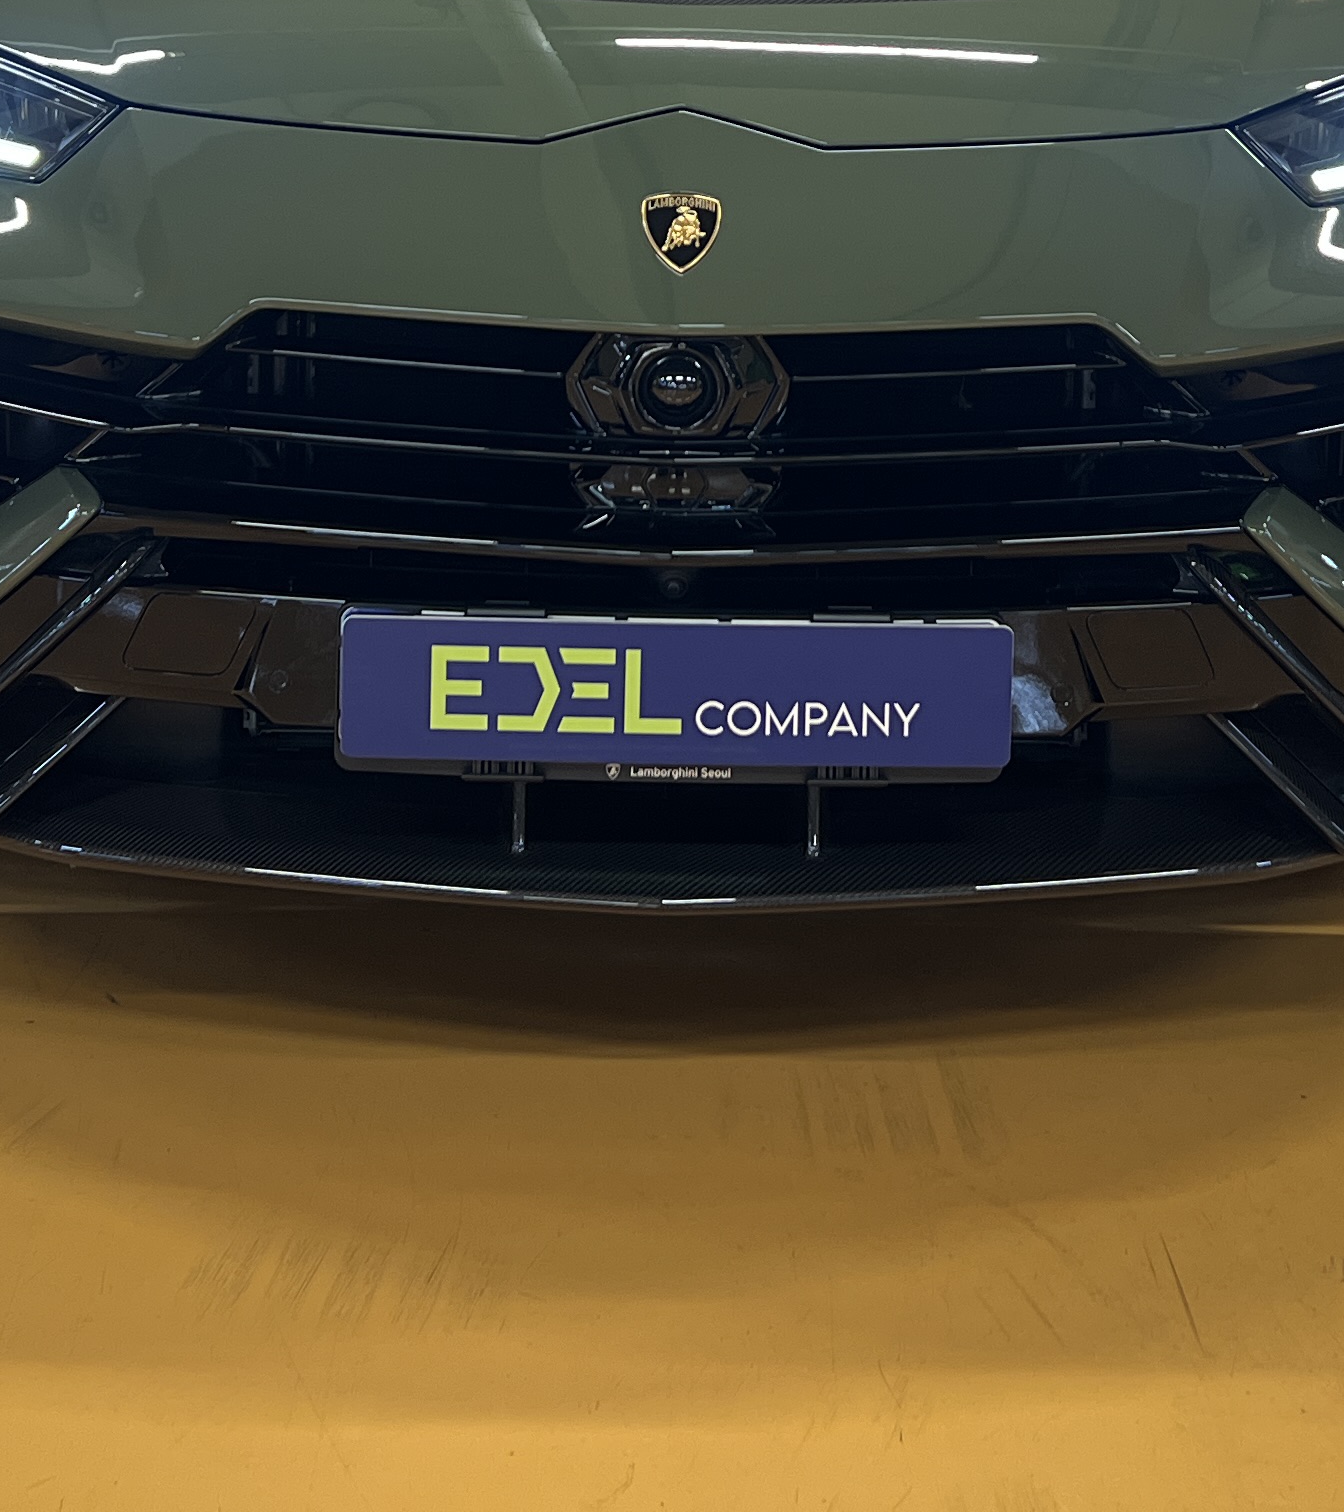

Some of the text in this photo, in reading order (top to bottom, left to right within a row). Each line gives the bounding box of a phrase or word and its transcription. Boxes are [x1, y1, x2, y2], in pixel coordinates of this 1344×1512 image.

[647, 196, 716, 213] LAMBORGHINI
[430, 645, 921, 737] EDEL COMPANY
[630, 766, 732, 780] Lamborghini Seoul
